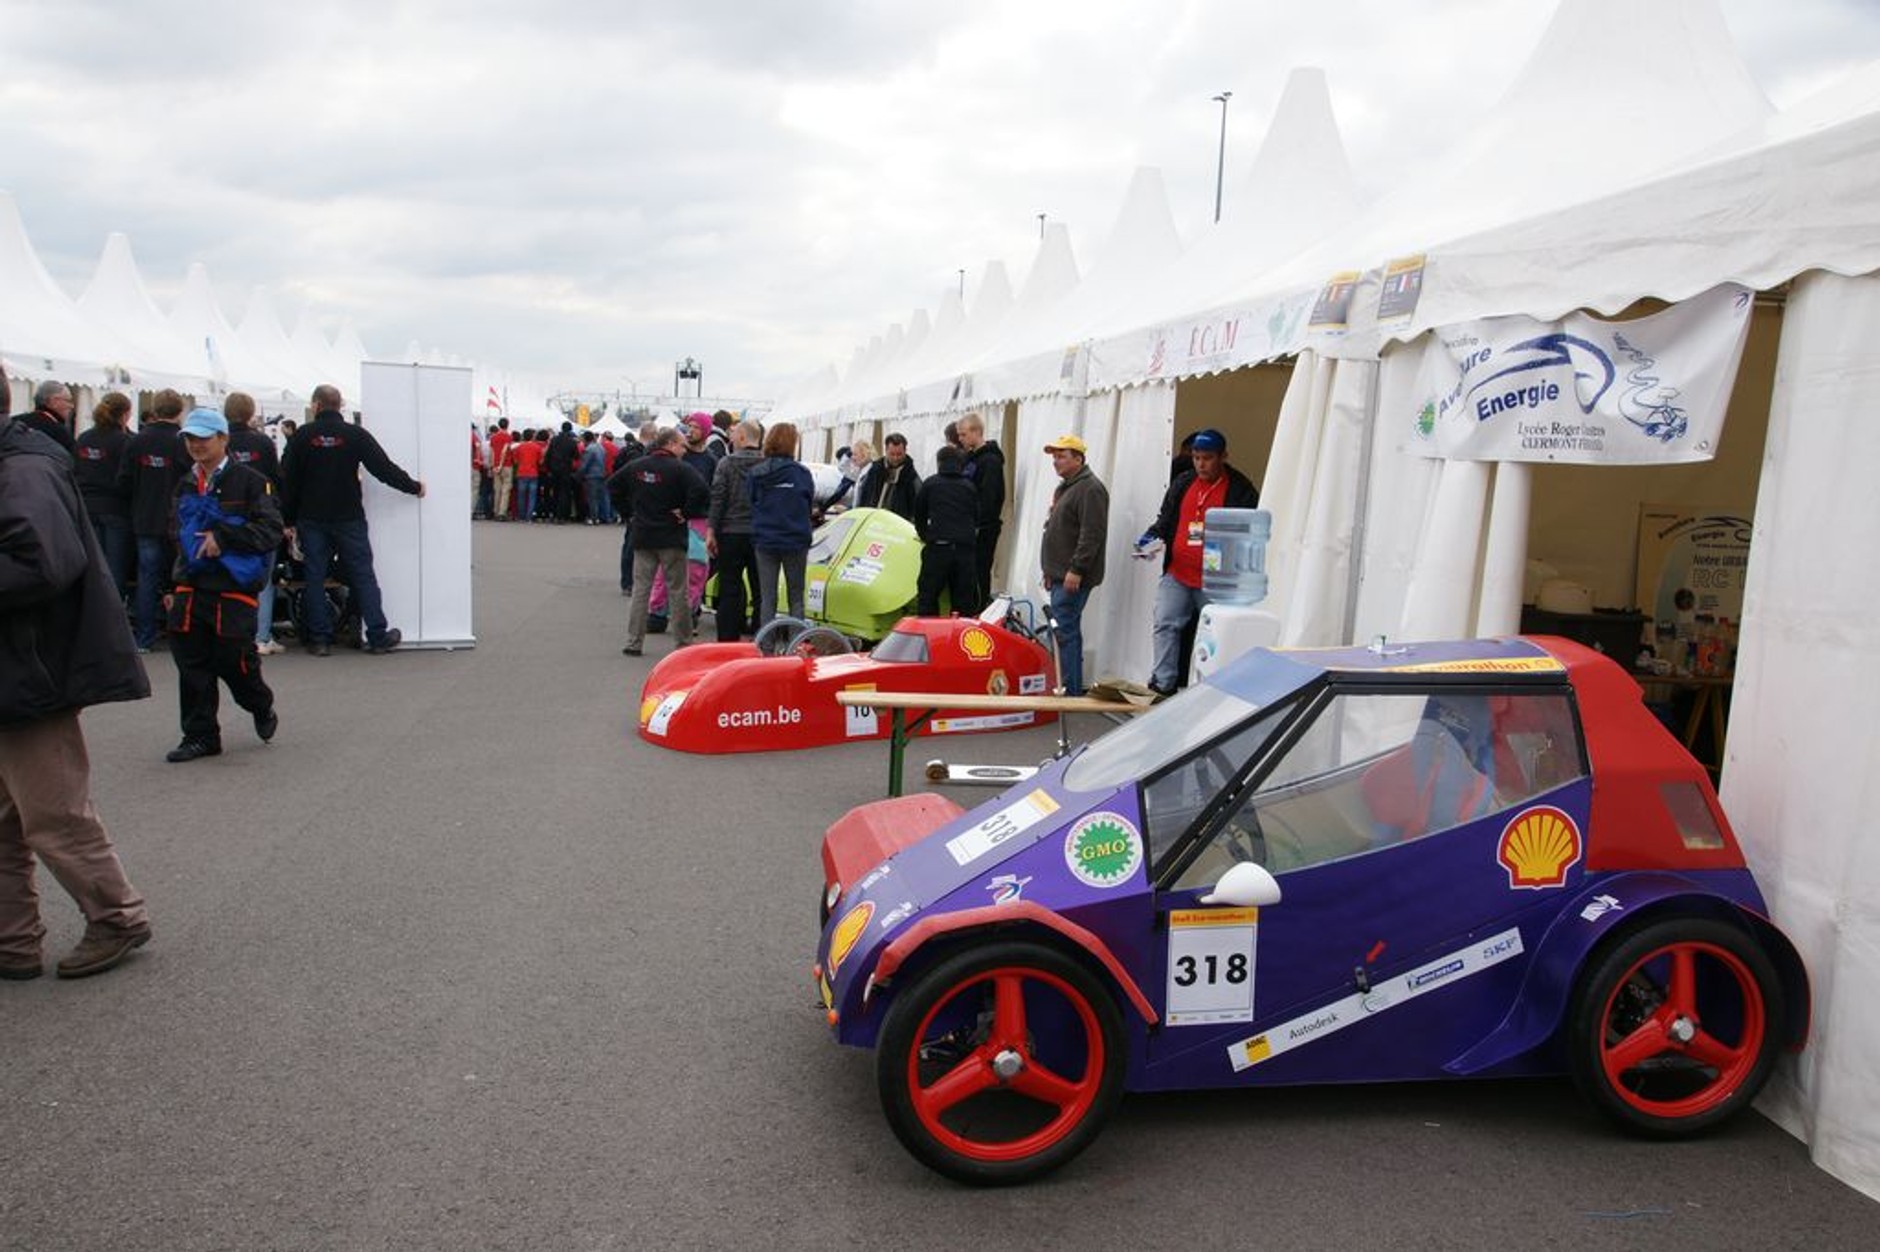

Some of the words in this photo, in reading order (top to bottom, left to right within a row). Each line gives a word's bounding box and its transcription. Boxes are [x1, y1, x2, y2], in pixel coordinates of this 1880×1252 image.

[1476, 379, 1560, 421] Energie
[717, 705, 801, 728] ecam.be
[980, 813, 1019, 844] 318
[1081, 839, 1127, 861] GMO
[1174, 953, 1248, 987] 318
[1289, 1013, 1338, 1040] Autodesk
